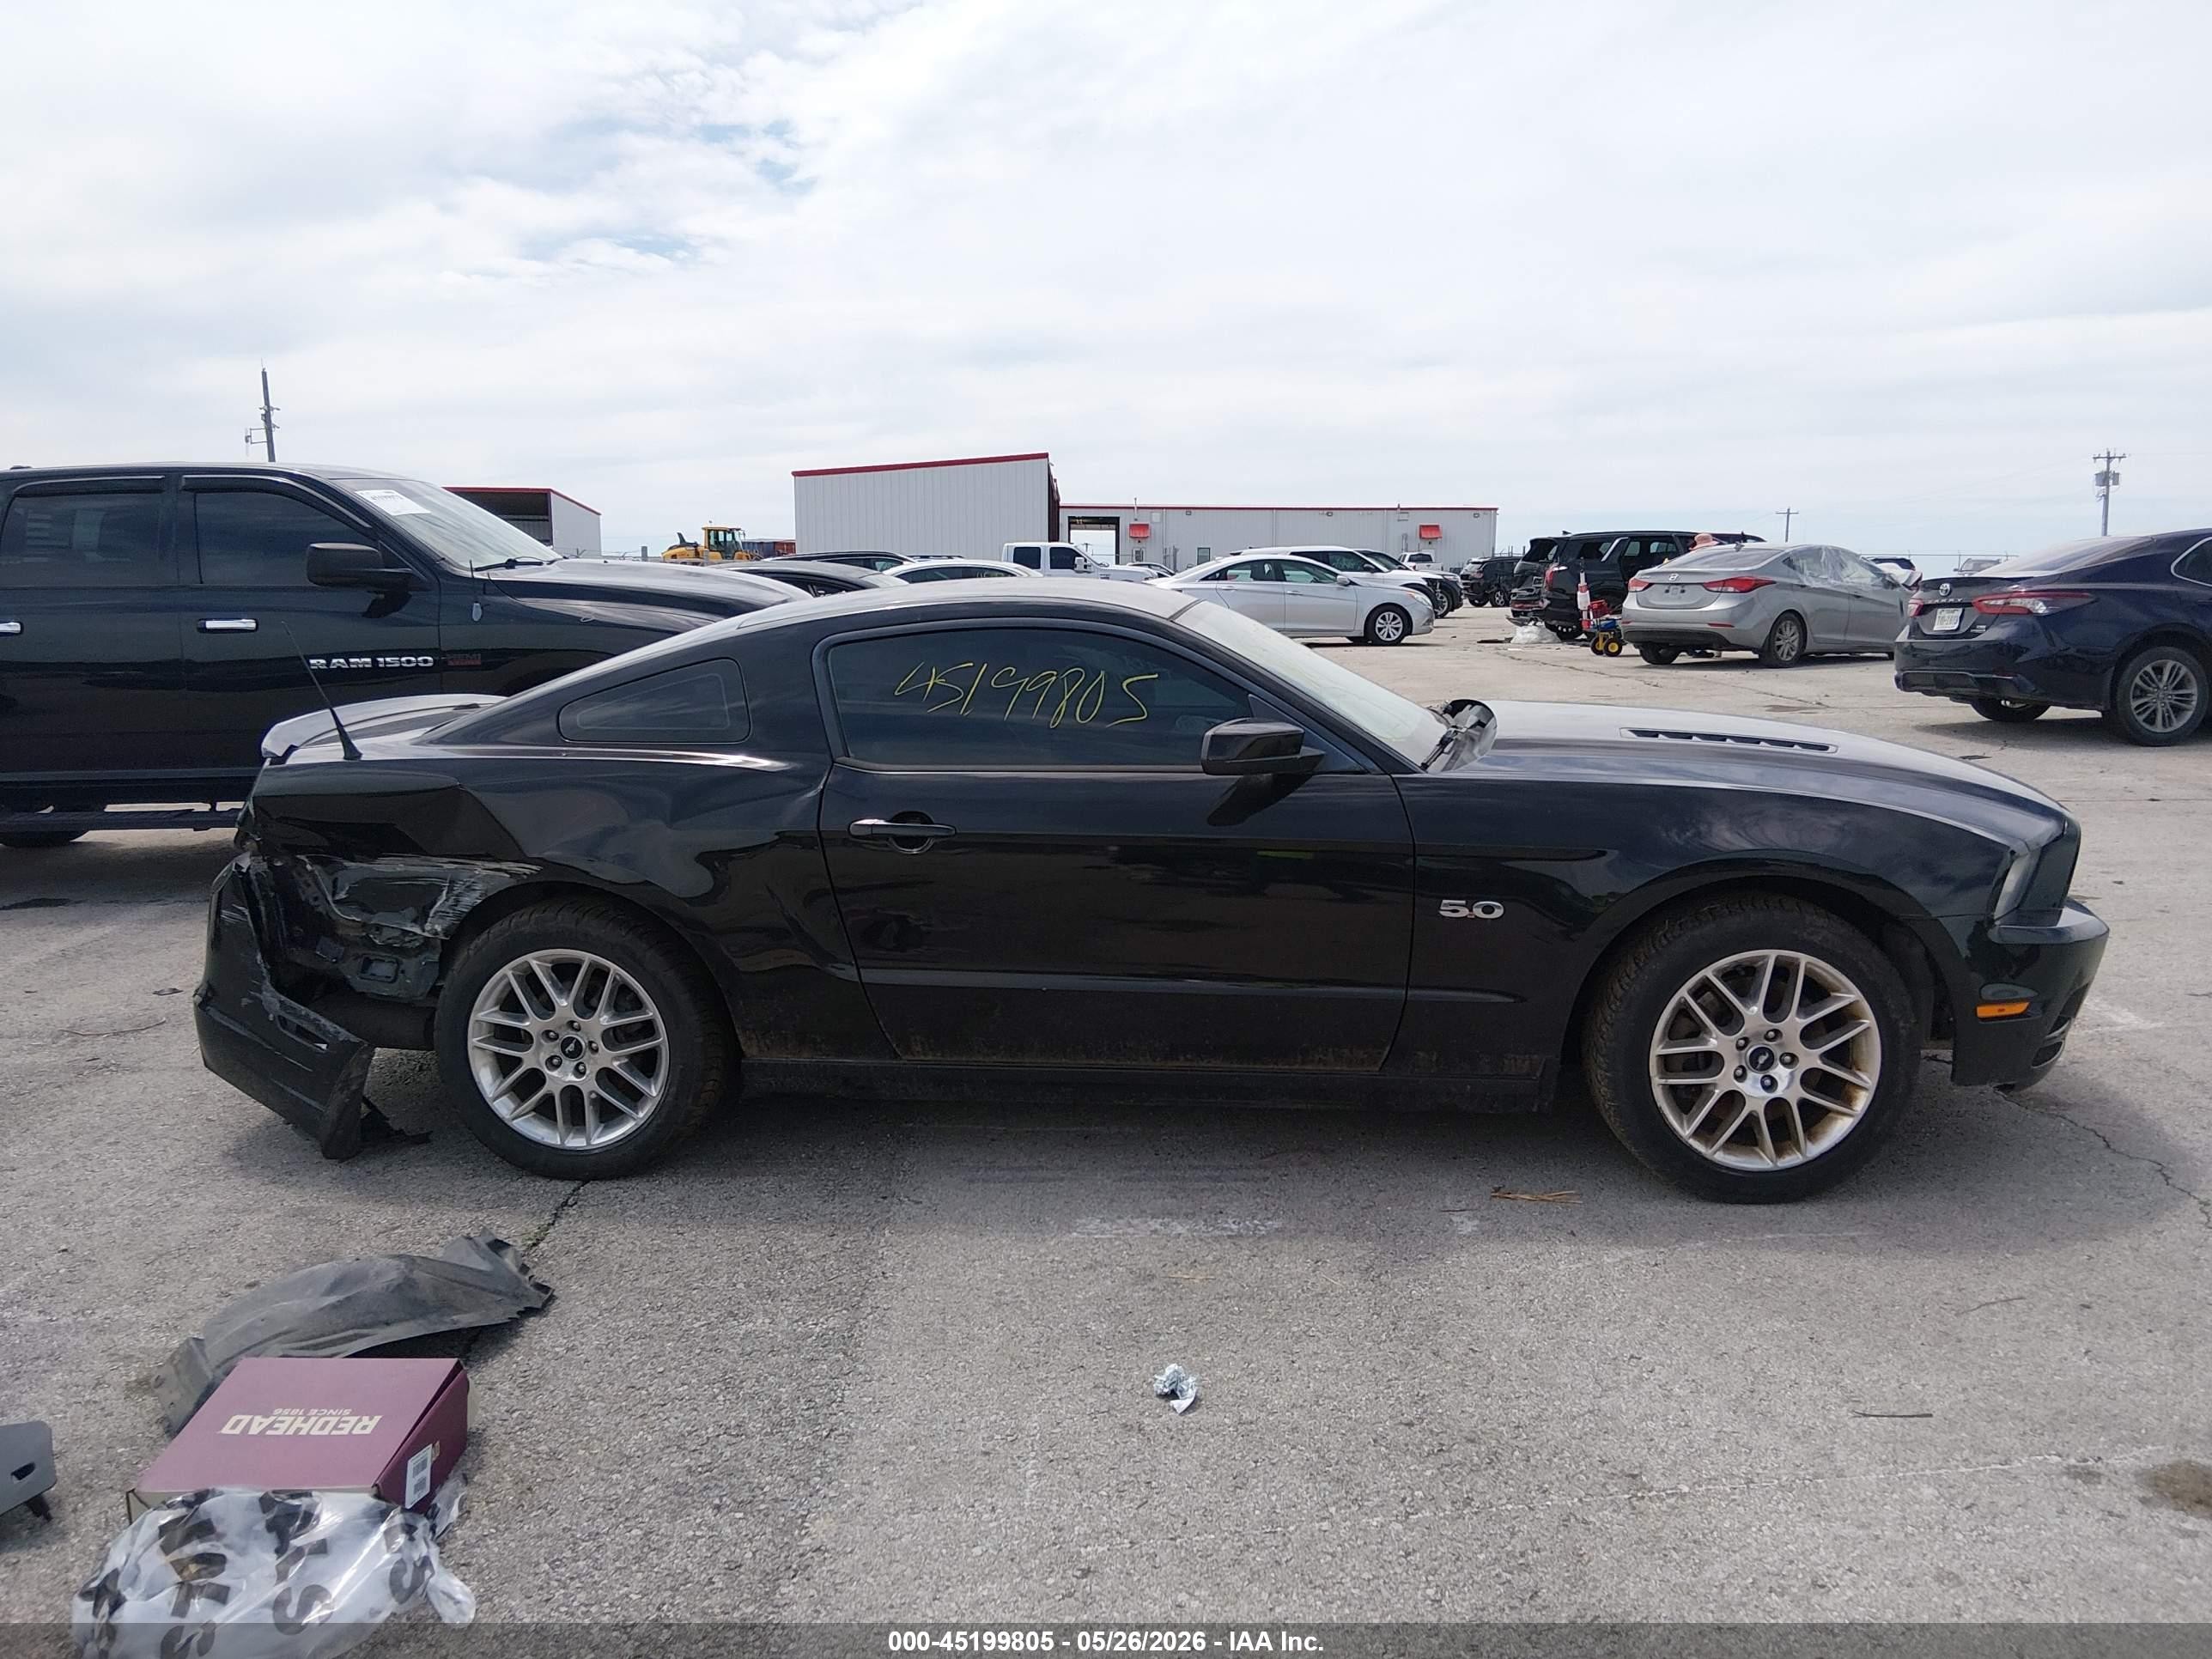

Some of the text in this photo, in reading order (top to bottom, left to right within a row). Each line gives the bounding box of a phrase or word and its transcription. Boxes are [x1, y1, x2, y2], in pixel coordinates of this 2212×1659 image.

[308, 658, 372, 669] RAM
[376, 656, 434, 667] 1500
[894, 661, 1158, 728] 45199805
[1438, 899, 1504, 919] 5.0
[217, 1414, 383, 1436] REDHEAD
